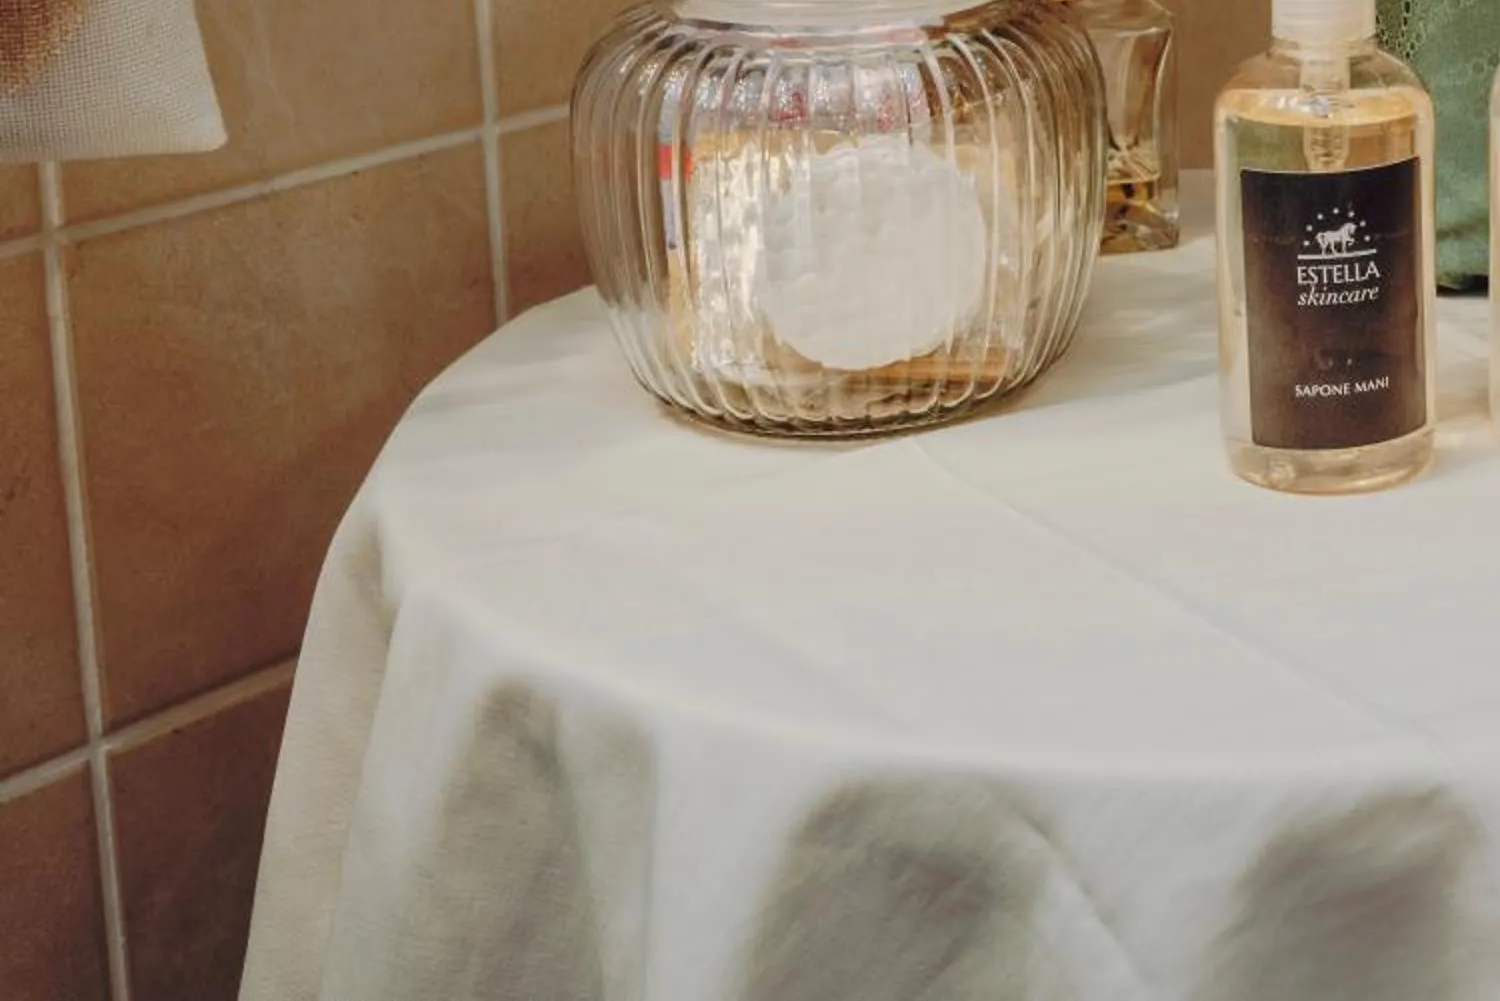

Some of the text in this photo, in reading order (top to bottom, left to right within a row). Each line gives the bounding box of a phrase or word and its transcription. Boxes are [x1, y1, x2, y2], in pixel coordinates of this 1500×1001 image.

[1297, 260, 1380, 285] ESTELLA
[1297, 284, 1379, 306] skincare
[1295, 376, 1389, 397] SAPONE MANI
